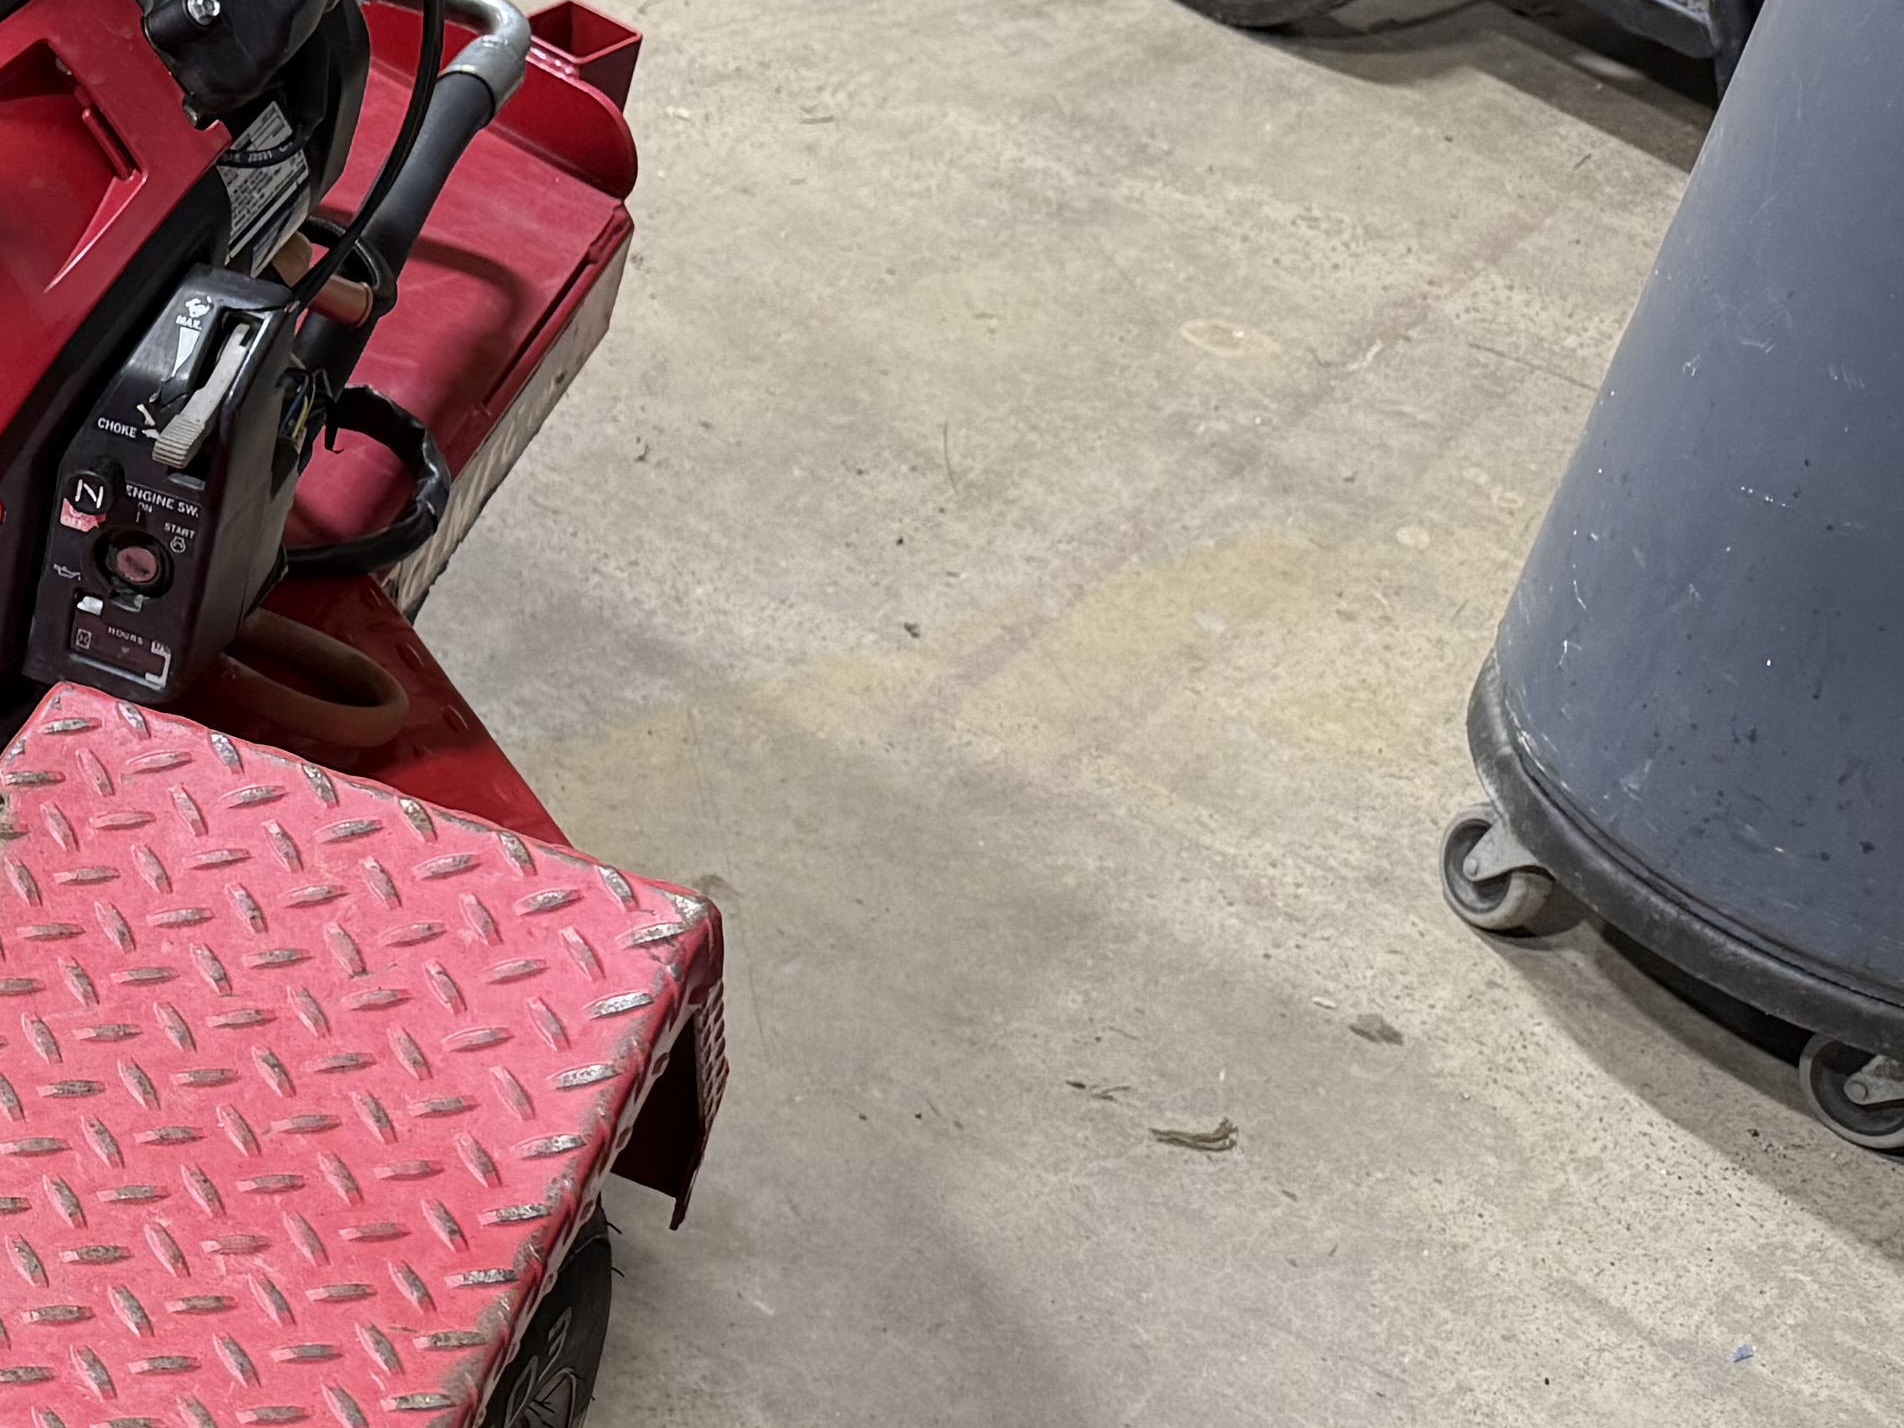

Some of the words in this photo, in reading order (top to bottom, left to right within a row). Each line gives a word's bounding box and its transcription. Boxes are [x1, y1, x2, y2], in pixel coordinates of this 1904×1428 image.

[97, 417, 138, 439] CHOKE
[125, 484, 174, 510] ENGINE
[178, 501, 200, 519] SW.
[138, 501, 154, 514] ON
[164, 522, 196, 538] START
